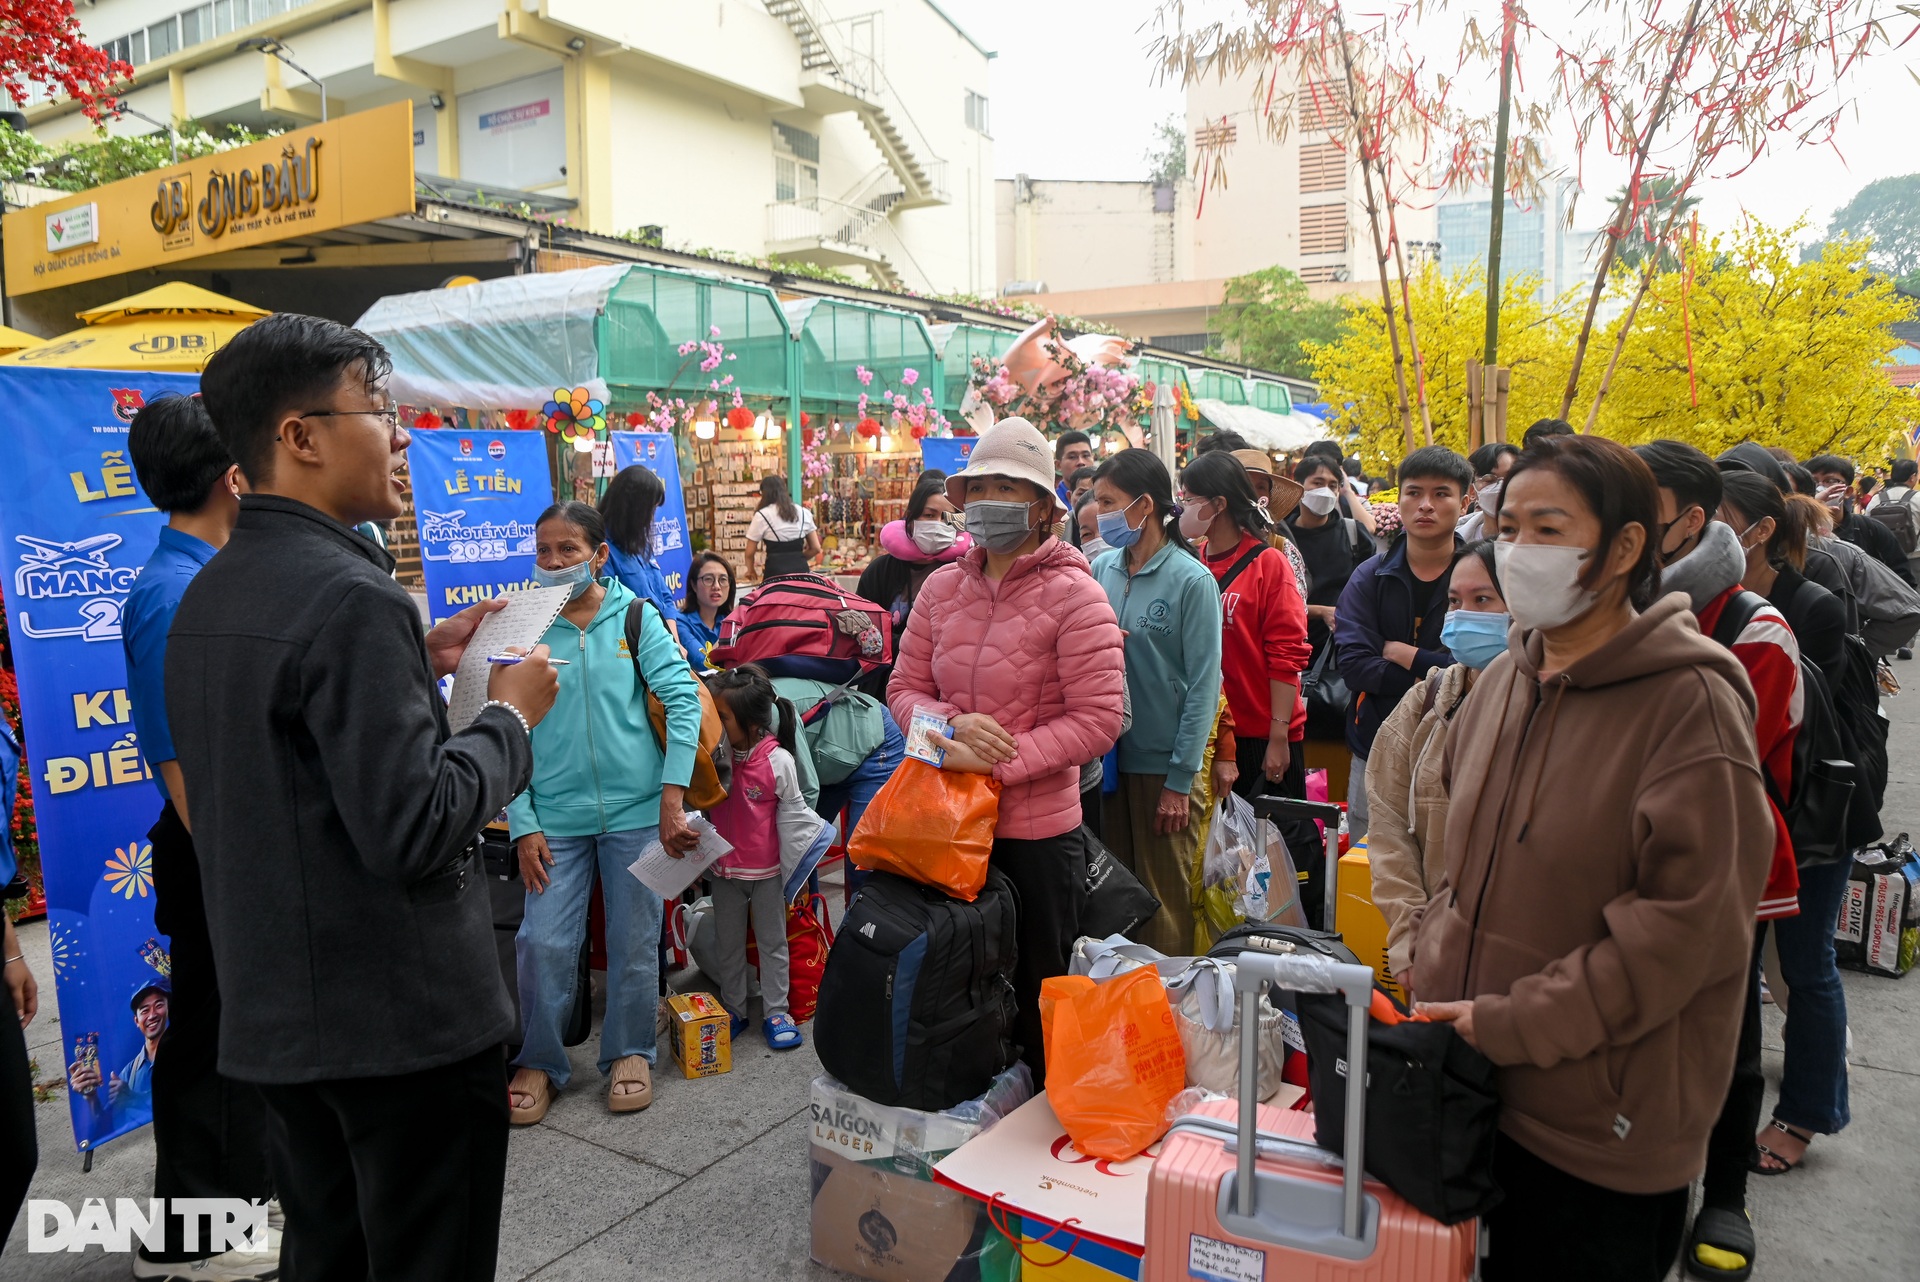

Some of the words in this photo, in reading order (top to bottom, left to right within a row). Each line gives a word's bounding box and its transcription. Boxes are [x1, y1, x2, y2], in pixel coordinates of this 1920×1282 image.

[198, 168, 257, 238] ÔNG
[70, 450, 136, 503] LỄ
[444, 469, 470, 495] LỄ
[474, 468, 522, 494] TIỄN
[428, 526, 472, 541] MANG
[472, 521, 498, 539] TẾT
[498, 520, 518, 539] VỀ
[519, 523, 537, 538] NH
[448, 540, 508, 563] 2025
[27, 568, 137, 598] MANG
[445, 584, 493, 605] KHU
[73, 689, 132, 728] KH
[44, 733, 153, 794] ĐIỂ
[811, 1103, 884, 1142] SAIGON
[816, 1125, 873, 1154] LAGER
[1040, 1174, 1098, 1198] Vietcombank
